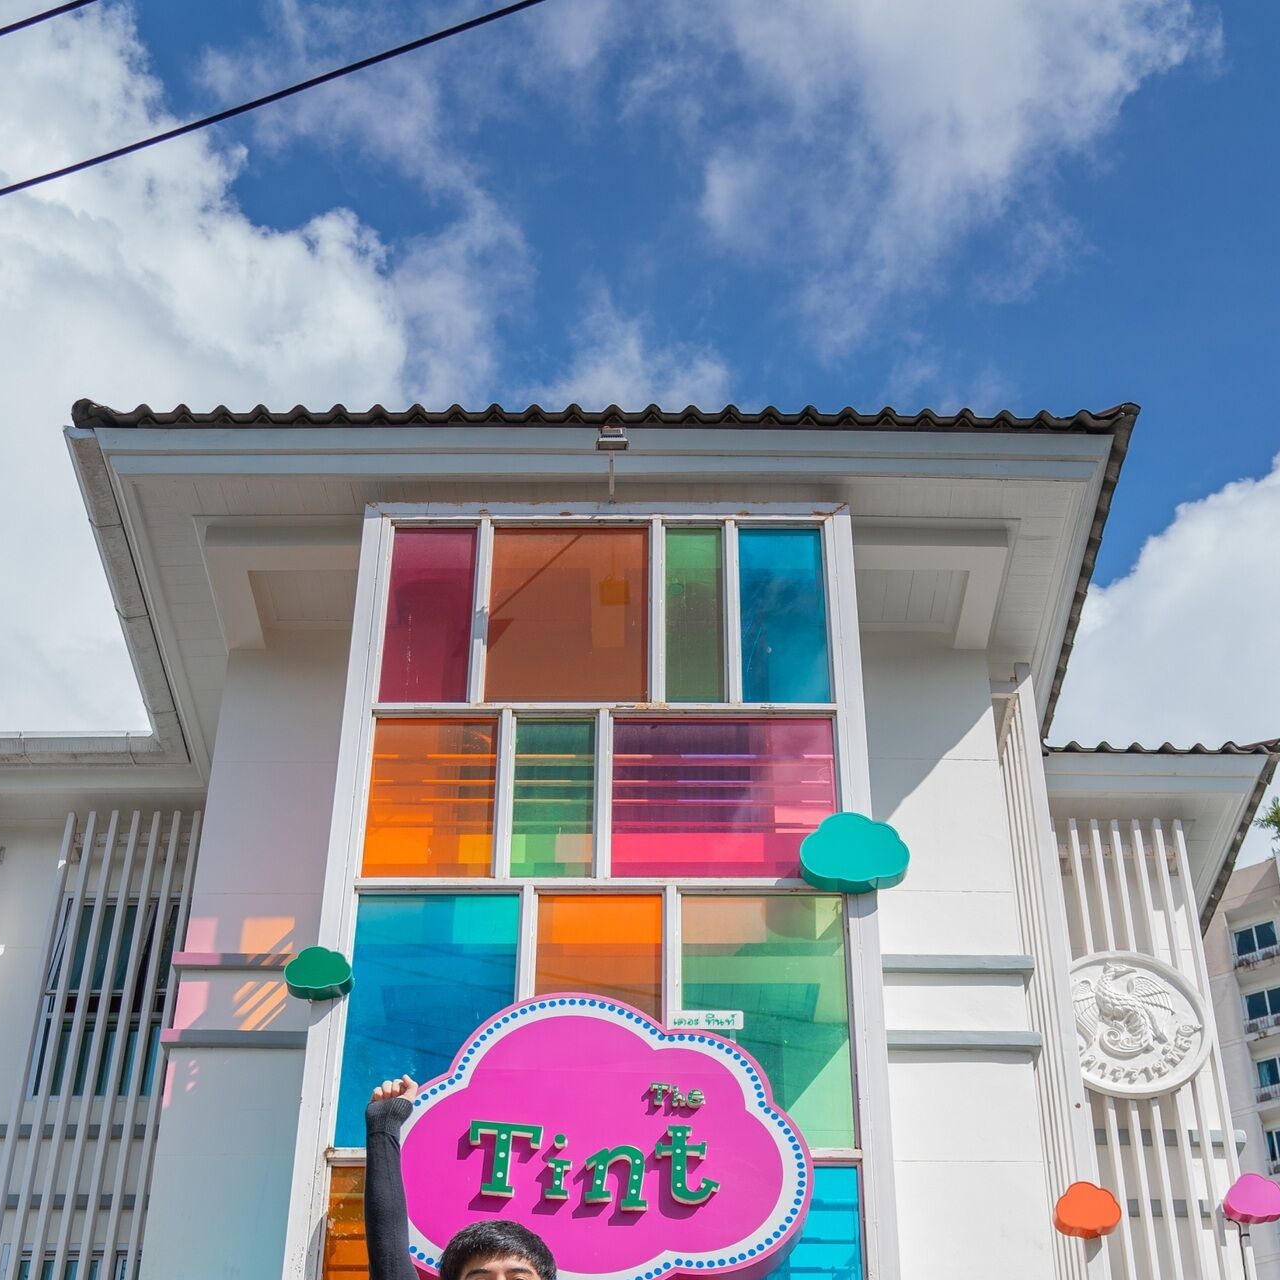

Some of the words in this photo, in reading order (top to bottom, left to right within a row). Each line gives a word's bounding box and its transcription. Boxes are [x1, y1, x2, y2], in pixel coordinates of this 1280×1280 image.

[673, 1018, 699, 1026] เดอะ
[1079, 1025, 1202, 1084] าคารราชพัสดุ
[650, 1081, 706, 1109] The
[469, 1120, 720, 1211] Tint
